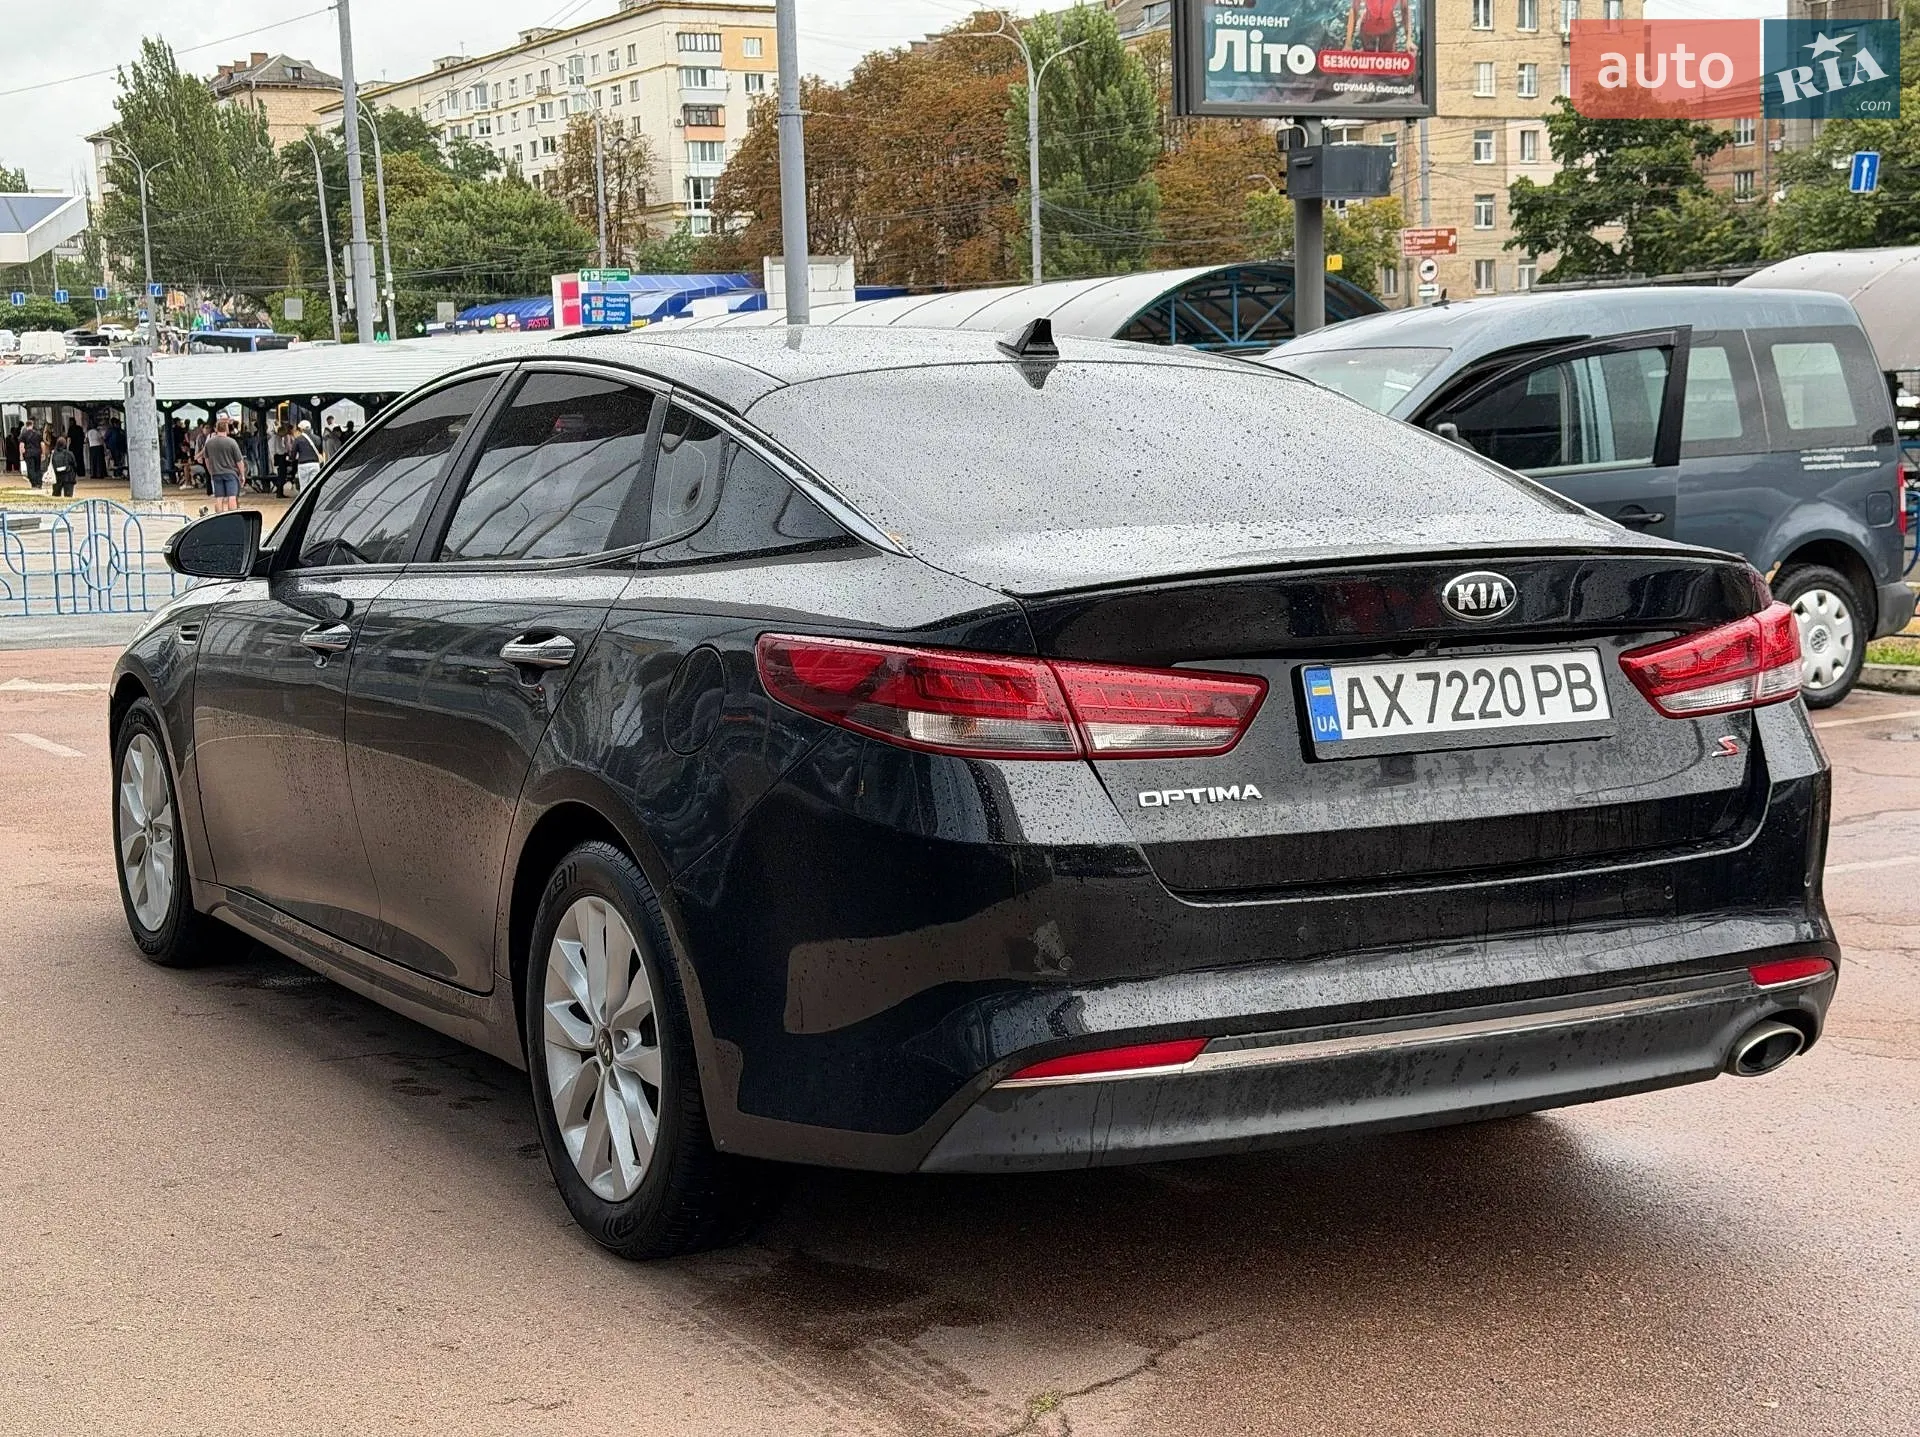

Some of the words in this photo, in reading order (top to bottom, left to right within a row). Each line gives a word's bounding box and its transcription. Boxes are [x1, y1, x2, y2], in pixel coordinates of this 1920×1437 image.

[1214, 10, 1290, 28] абонемент
[1208, 29, 1317, 75] Літо
[1322, 54, 1411, 71] БЕЗКОШТОВНО
[1456, 582, 1508, 610] KIA
[1346, 673, 1413, 730] AX
[1416, 666, 1526, 724] 7220
[1530, 662, 1598, 716] PB
[1317, 716, 1339, 733] UA
[1138, 784, 1263, 807] OPTIMA
